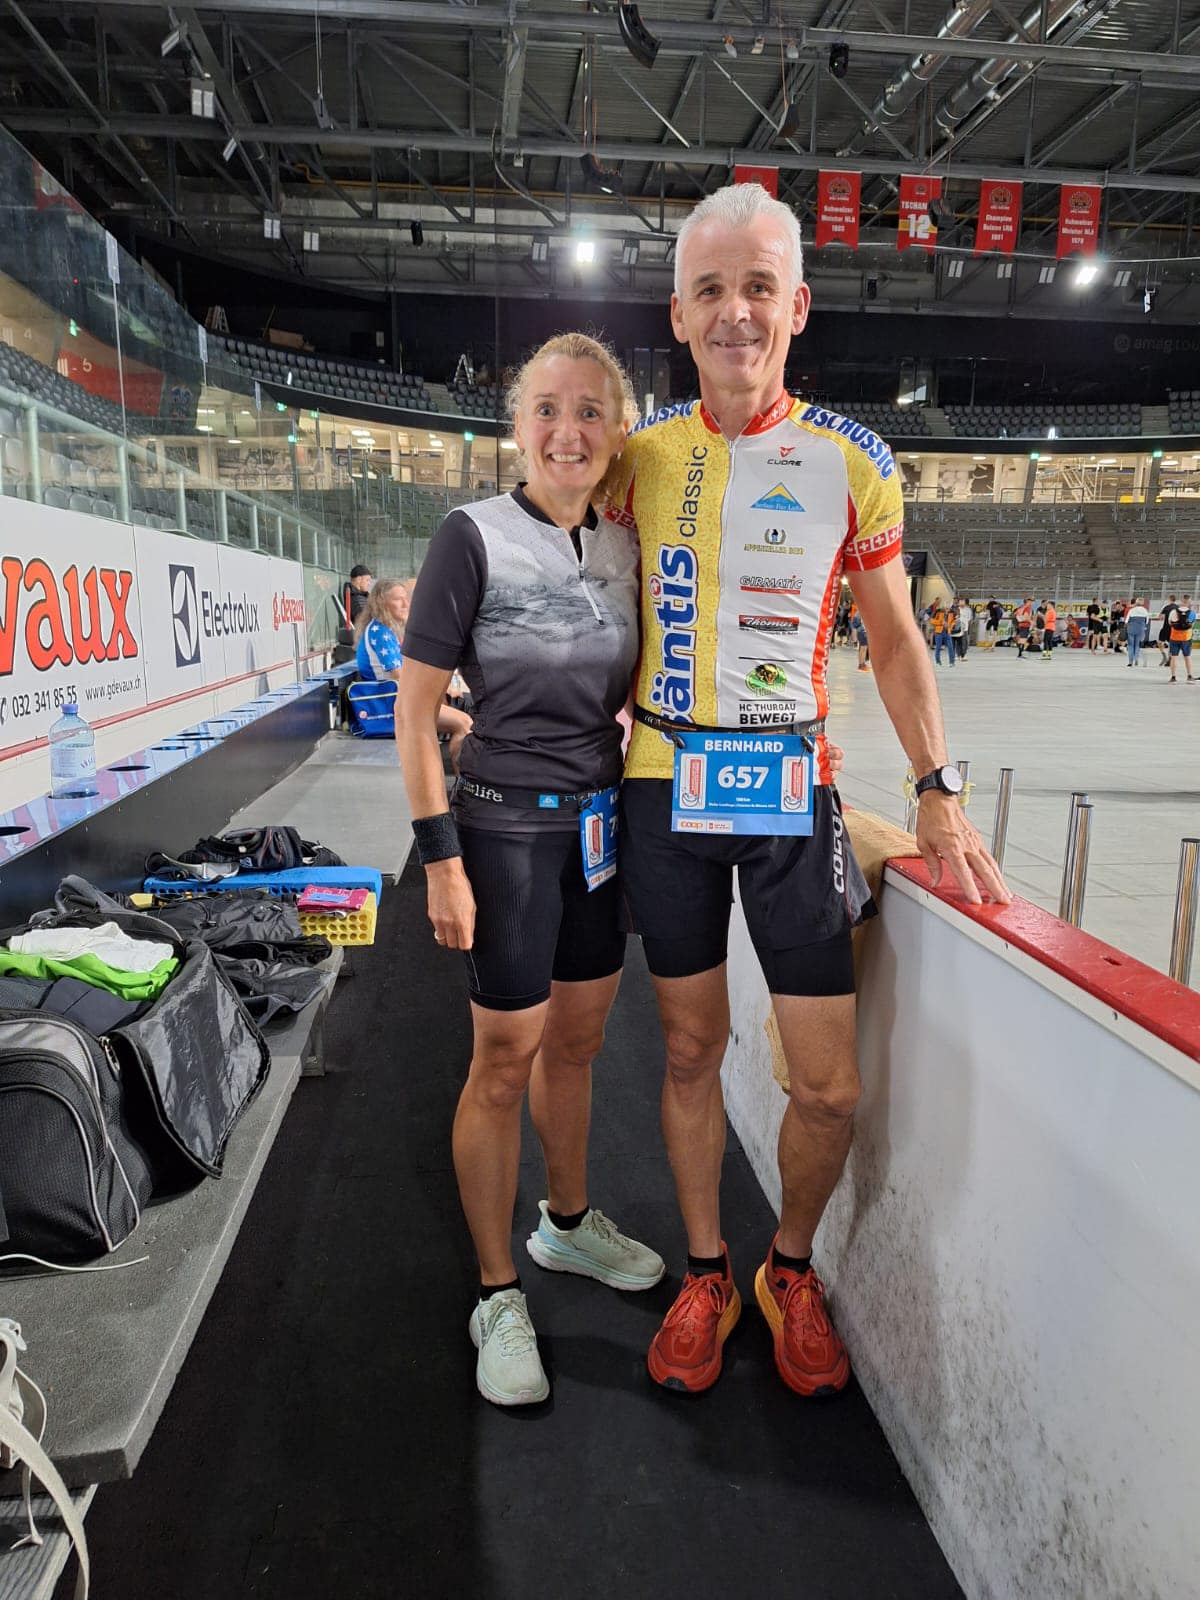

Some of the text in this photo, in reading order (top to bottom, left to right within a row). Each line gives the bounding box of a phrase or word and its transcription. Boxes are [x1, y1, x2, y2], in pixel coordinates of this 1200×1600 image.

[907, 213, 932, 239] 12
[800, 405, 896, 479] BSCHUSSIG
[676, 446, 707, 538] classic
[201, 590, 260, 638] Electrolux
[12, 674, 142, 718] 032 341 85 55 www.gdevaux.ch
[739, 703, 796, 712] HC THURGAU
[739, 712, 797, 725] BEWEGT
[704, 739, 784, 753] BERNHARD
[717, 765, 770, 789] 657
